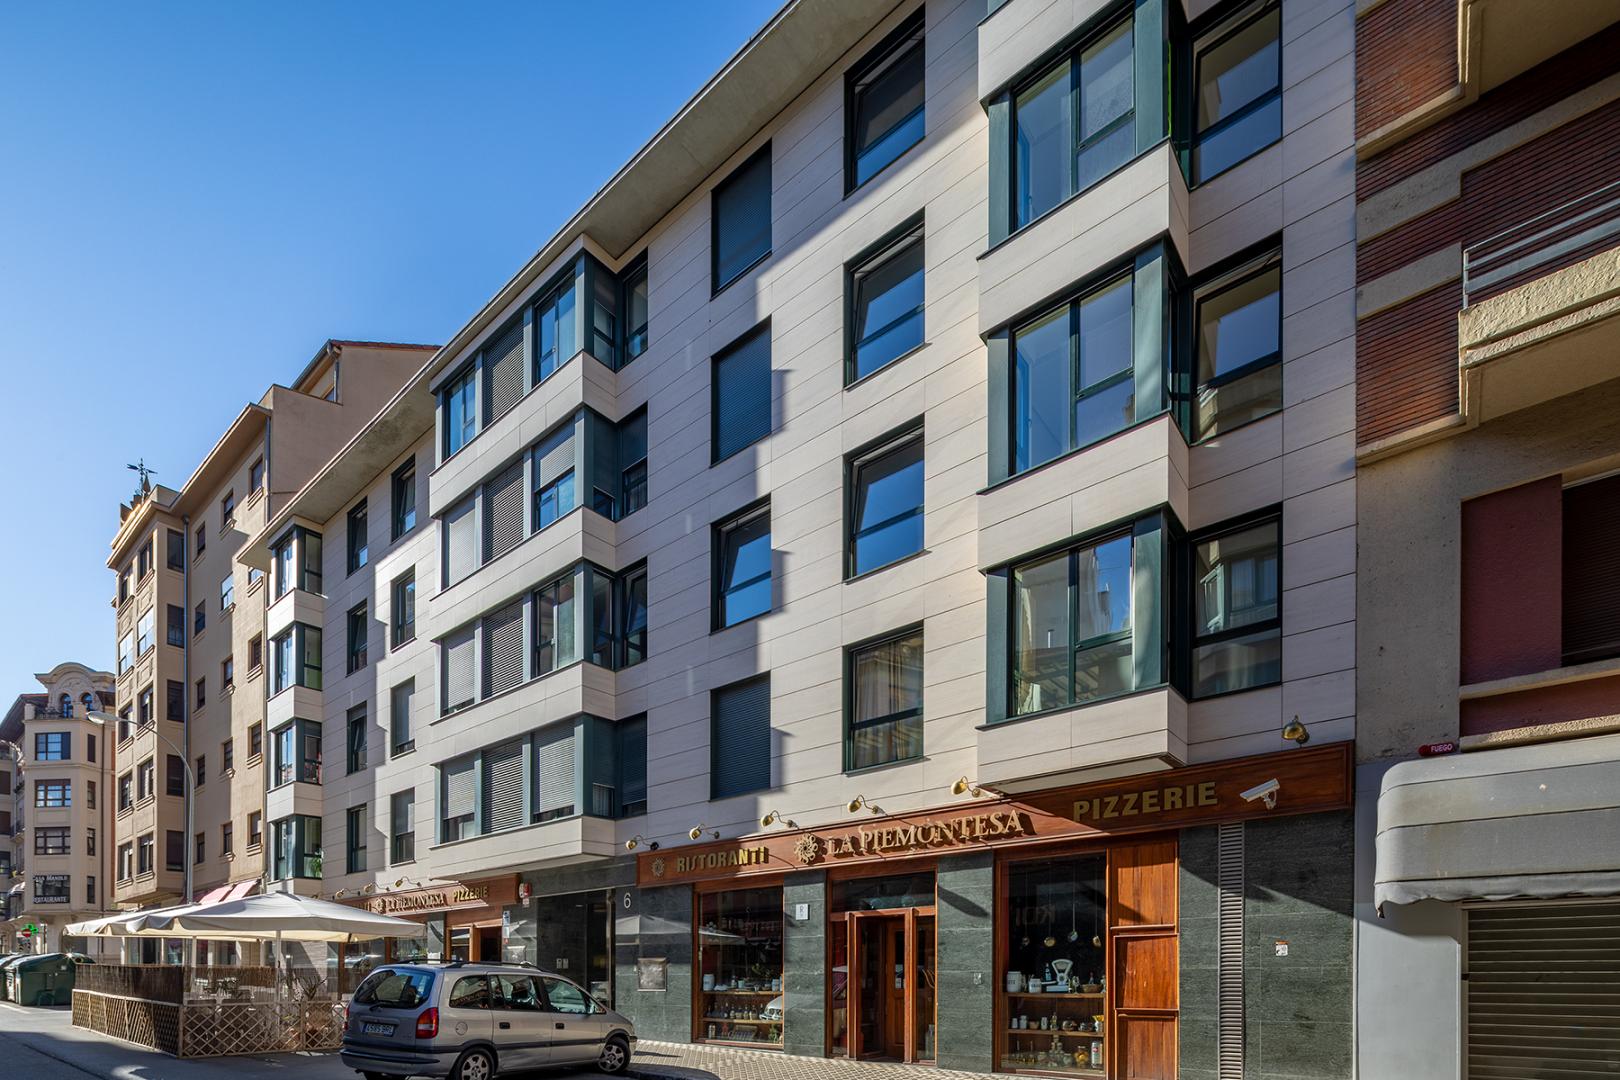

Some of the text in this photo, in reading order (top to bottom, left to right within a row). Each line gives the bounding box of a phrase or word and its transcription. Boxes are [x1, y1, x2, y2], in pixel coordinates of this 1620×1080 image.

[1431, 743, 1453, 753] FUEGO
[1073, 782, 1218, 821] PIZZERIE
[826, 810, 1024, 855] LA PIEMONTESA
[676, 847, 766, 872] RISTORANTI
[453, 886, 488, 901] PIZZERIE
[623, 892, 632, 909] 6
